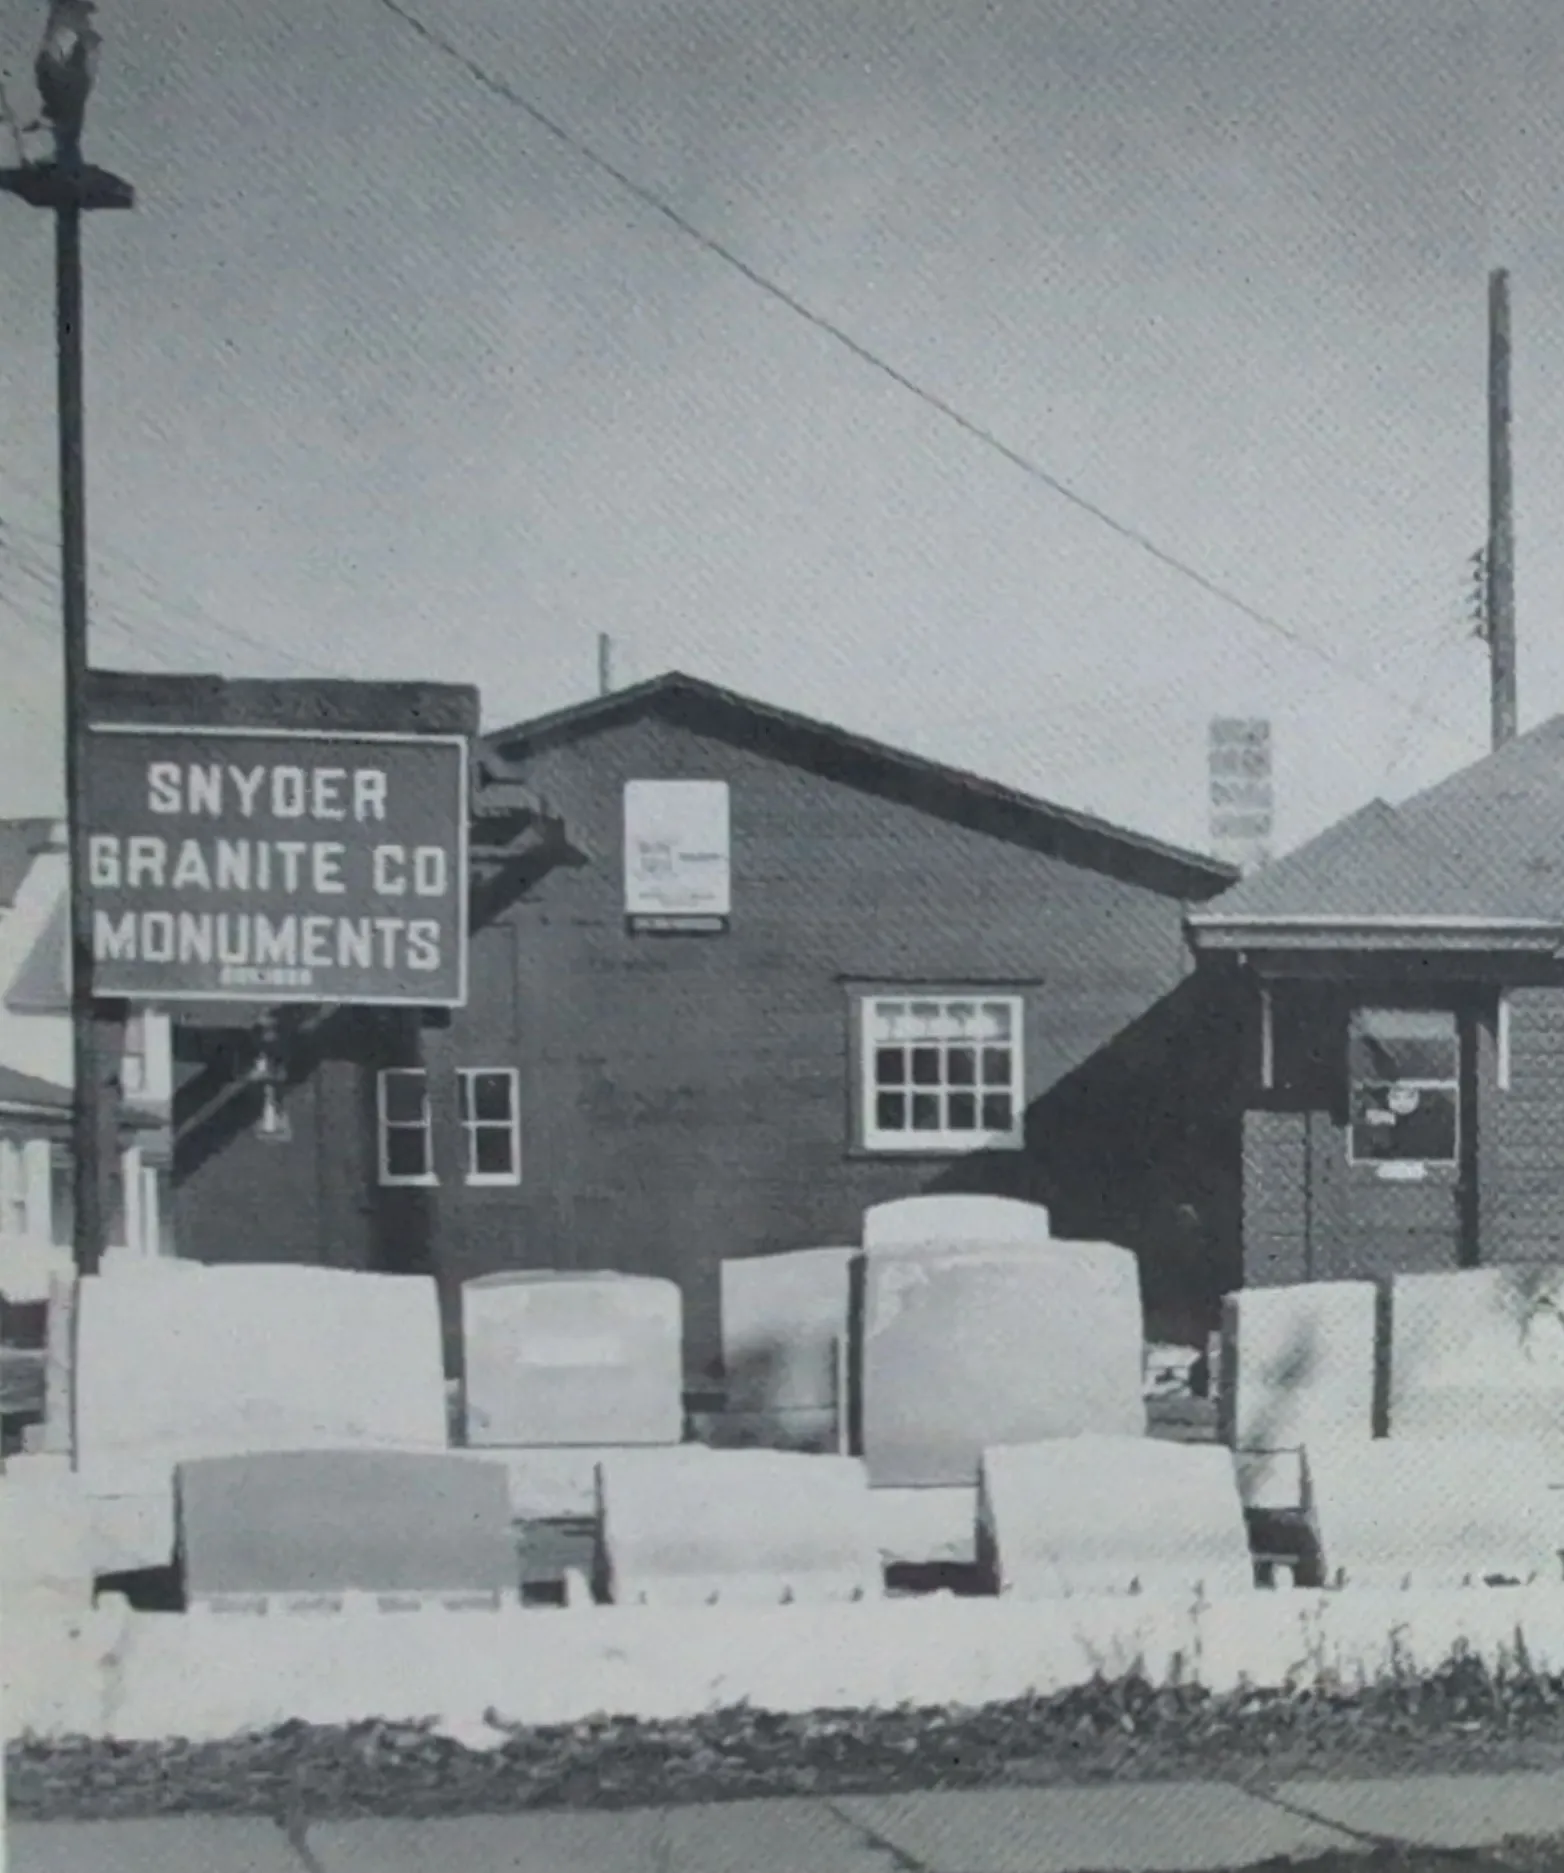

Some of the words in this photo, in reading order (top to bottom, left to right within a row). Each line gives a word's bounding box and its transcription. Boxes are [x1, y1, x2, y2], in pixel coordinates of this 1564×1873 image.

[147, 761, 388, 822] SNYDER
[88, 834, 347, 894] GRANITE
[372, 843, 448, 897] CO
[92, 909, 442, 971] MONUMENTS
